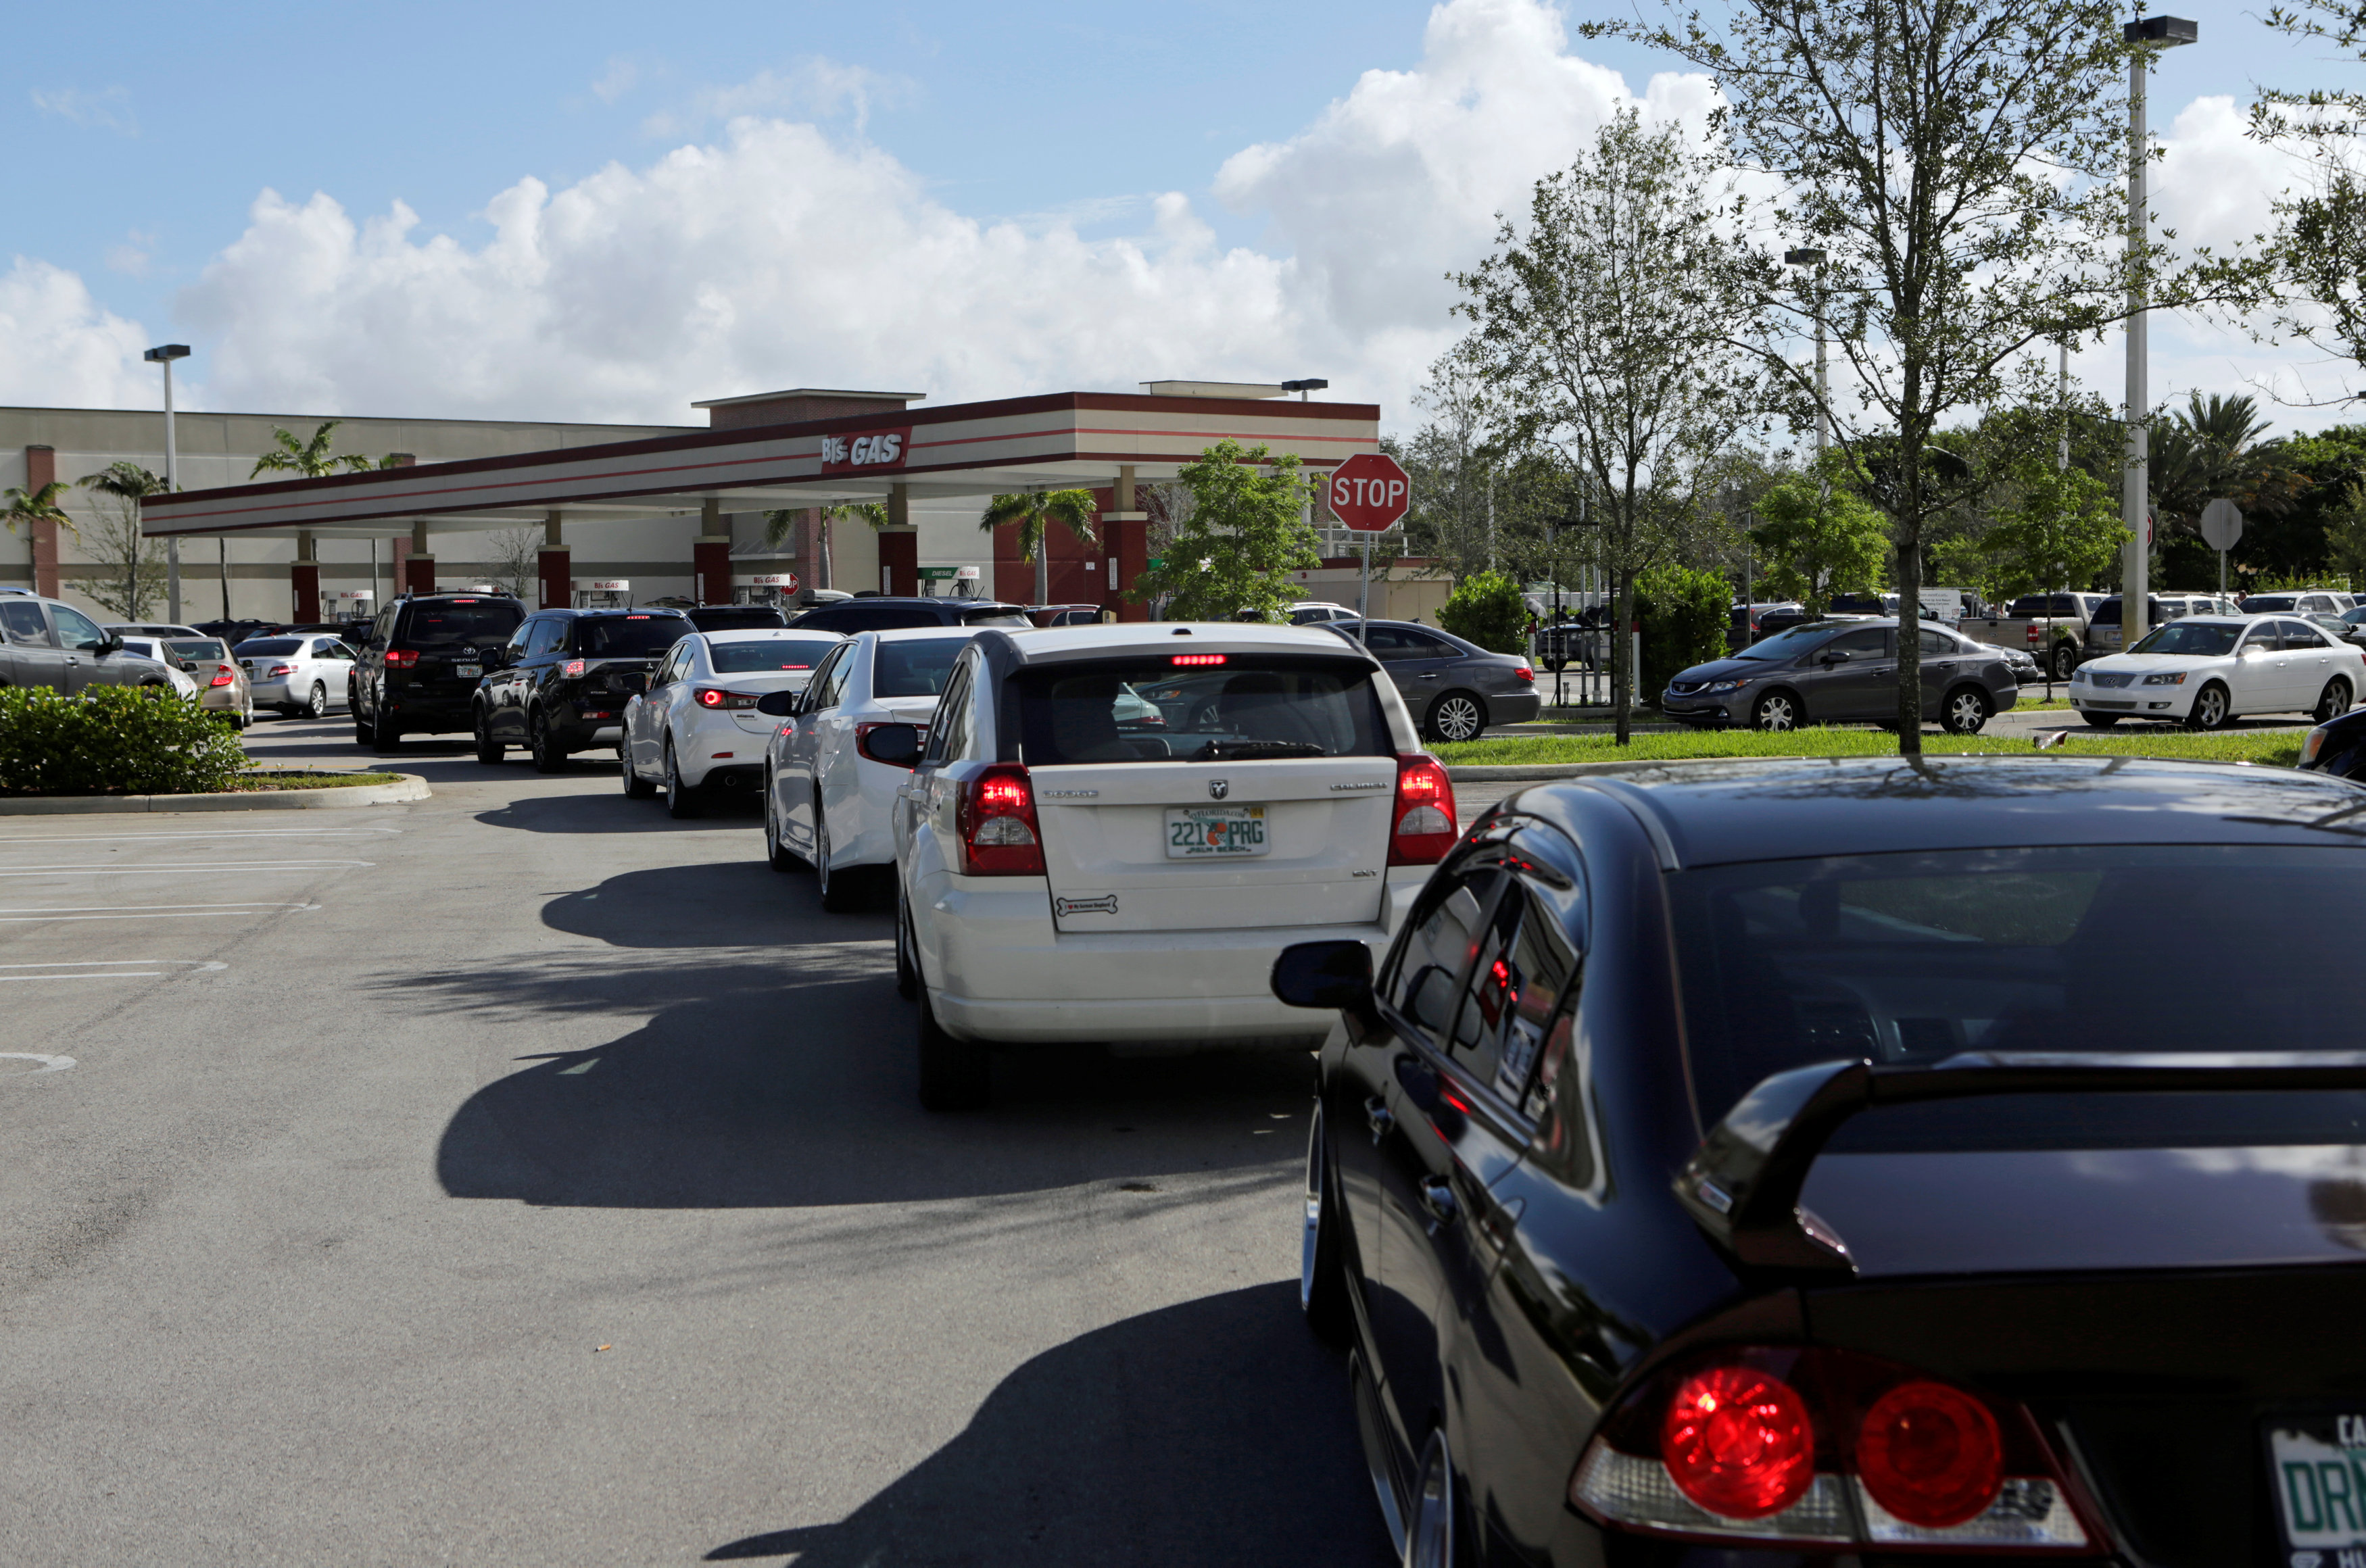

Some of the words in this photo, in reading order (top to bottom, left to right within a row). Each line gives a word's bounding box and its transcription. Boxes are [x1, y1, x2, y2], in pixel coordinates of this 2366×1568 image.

[851, 434, 902, 465] GAS
[1334, 477, 1405, 507] STOP
[1043, 790, 1098, 798] DODGE
[1330, 782, 1388, 791] CALIBER
[1171, 822, 1205, 846] 221
[1228, 820, 1263, 845] PRG
